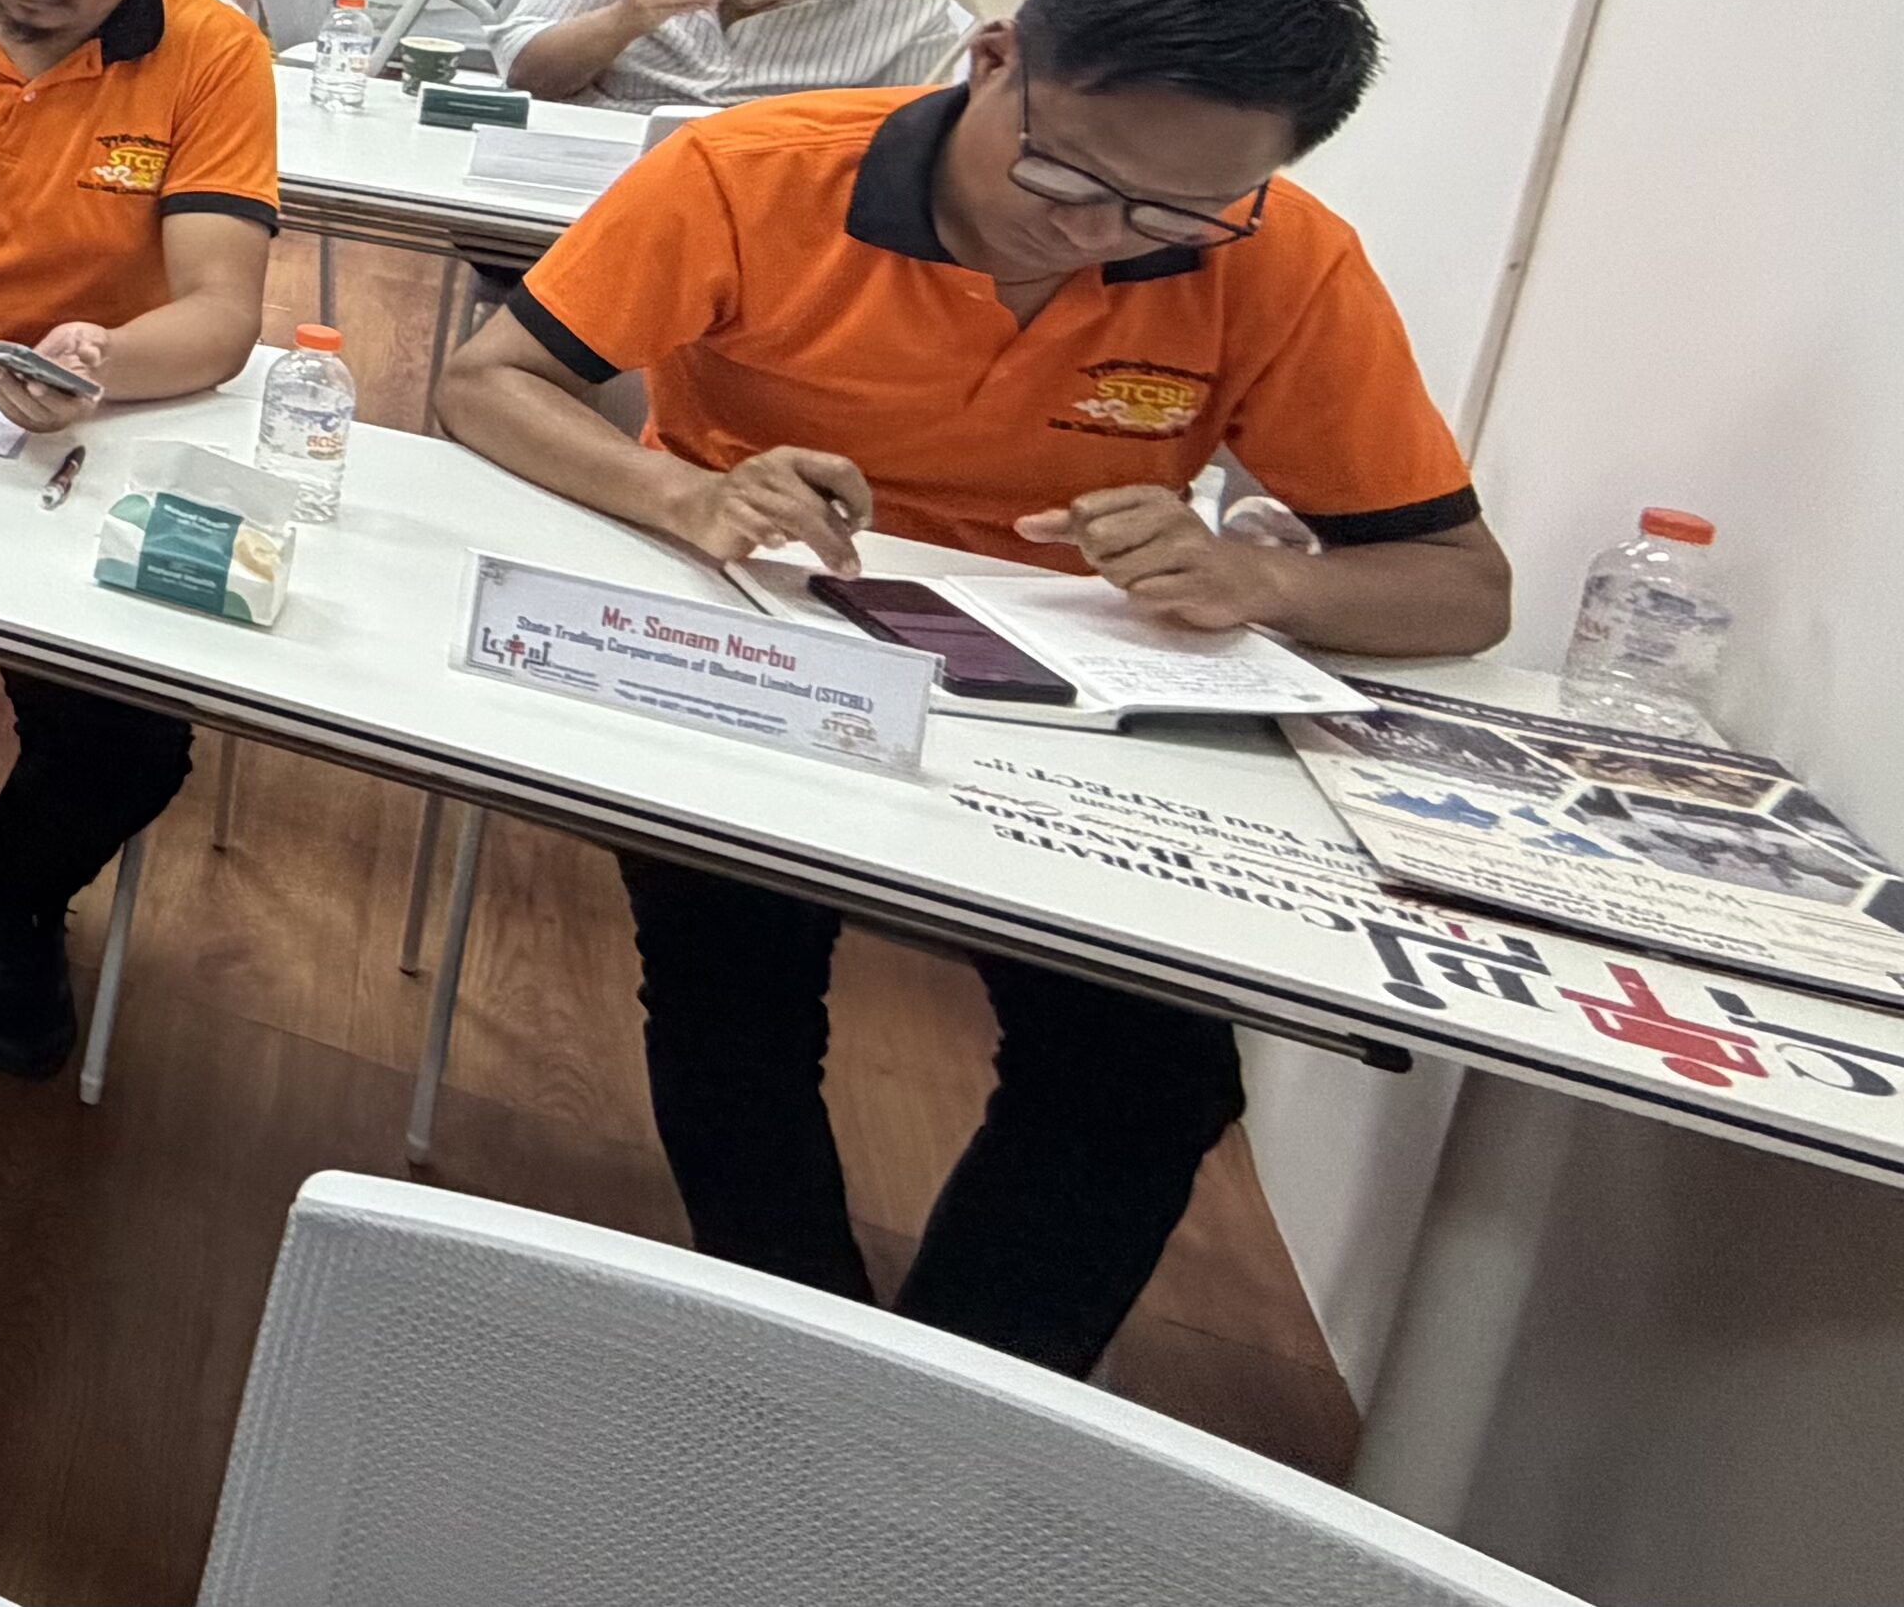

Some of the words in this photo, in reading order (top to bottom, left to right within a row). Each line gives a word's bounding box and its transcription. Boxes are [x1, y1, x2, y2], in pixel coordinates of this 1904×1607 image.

[106, 150, 165, 170] STCB
[600, 605, 638, 634] Mr.
[643, 616, 720, 654] Sonam
[726, 634, 797, 673] Norbu
[1022, 764, 1211, 824] EXPECT
[948, 793, 1208, 873] BANGKOK
[991, 824, 1355, 933] CORPORATE
